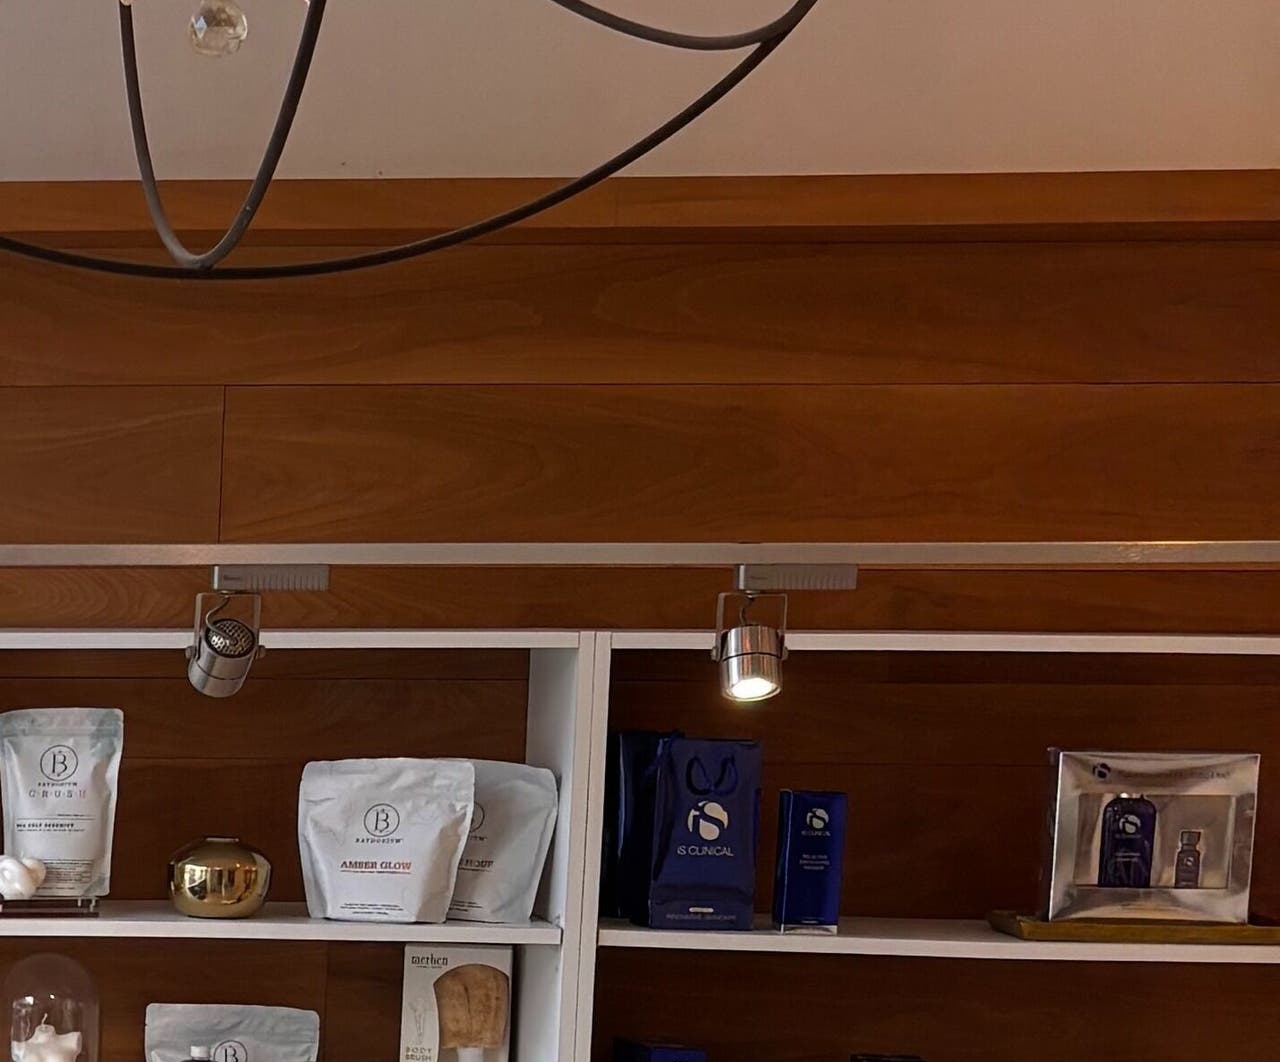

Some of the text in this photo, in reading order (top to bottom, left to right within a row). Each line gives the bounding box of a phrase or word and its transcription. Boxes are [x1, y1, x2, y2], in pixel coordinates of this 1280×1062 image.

[688, 846, 734, 856] CLINICAL
[340, 860, 412, 871] AMBER GLOW
